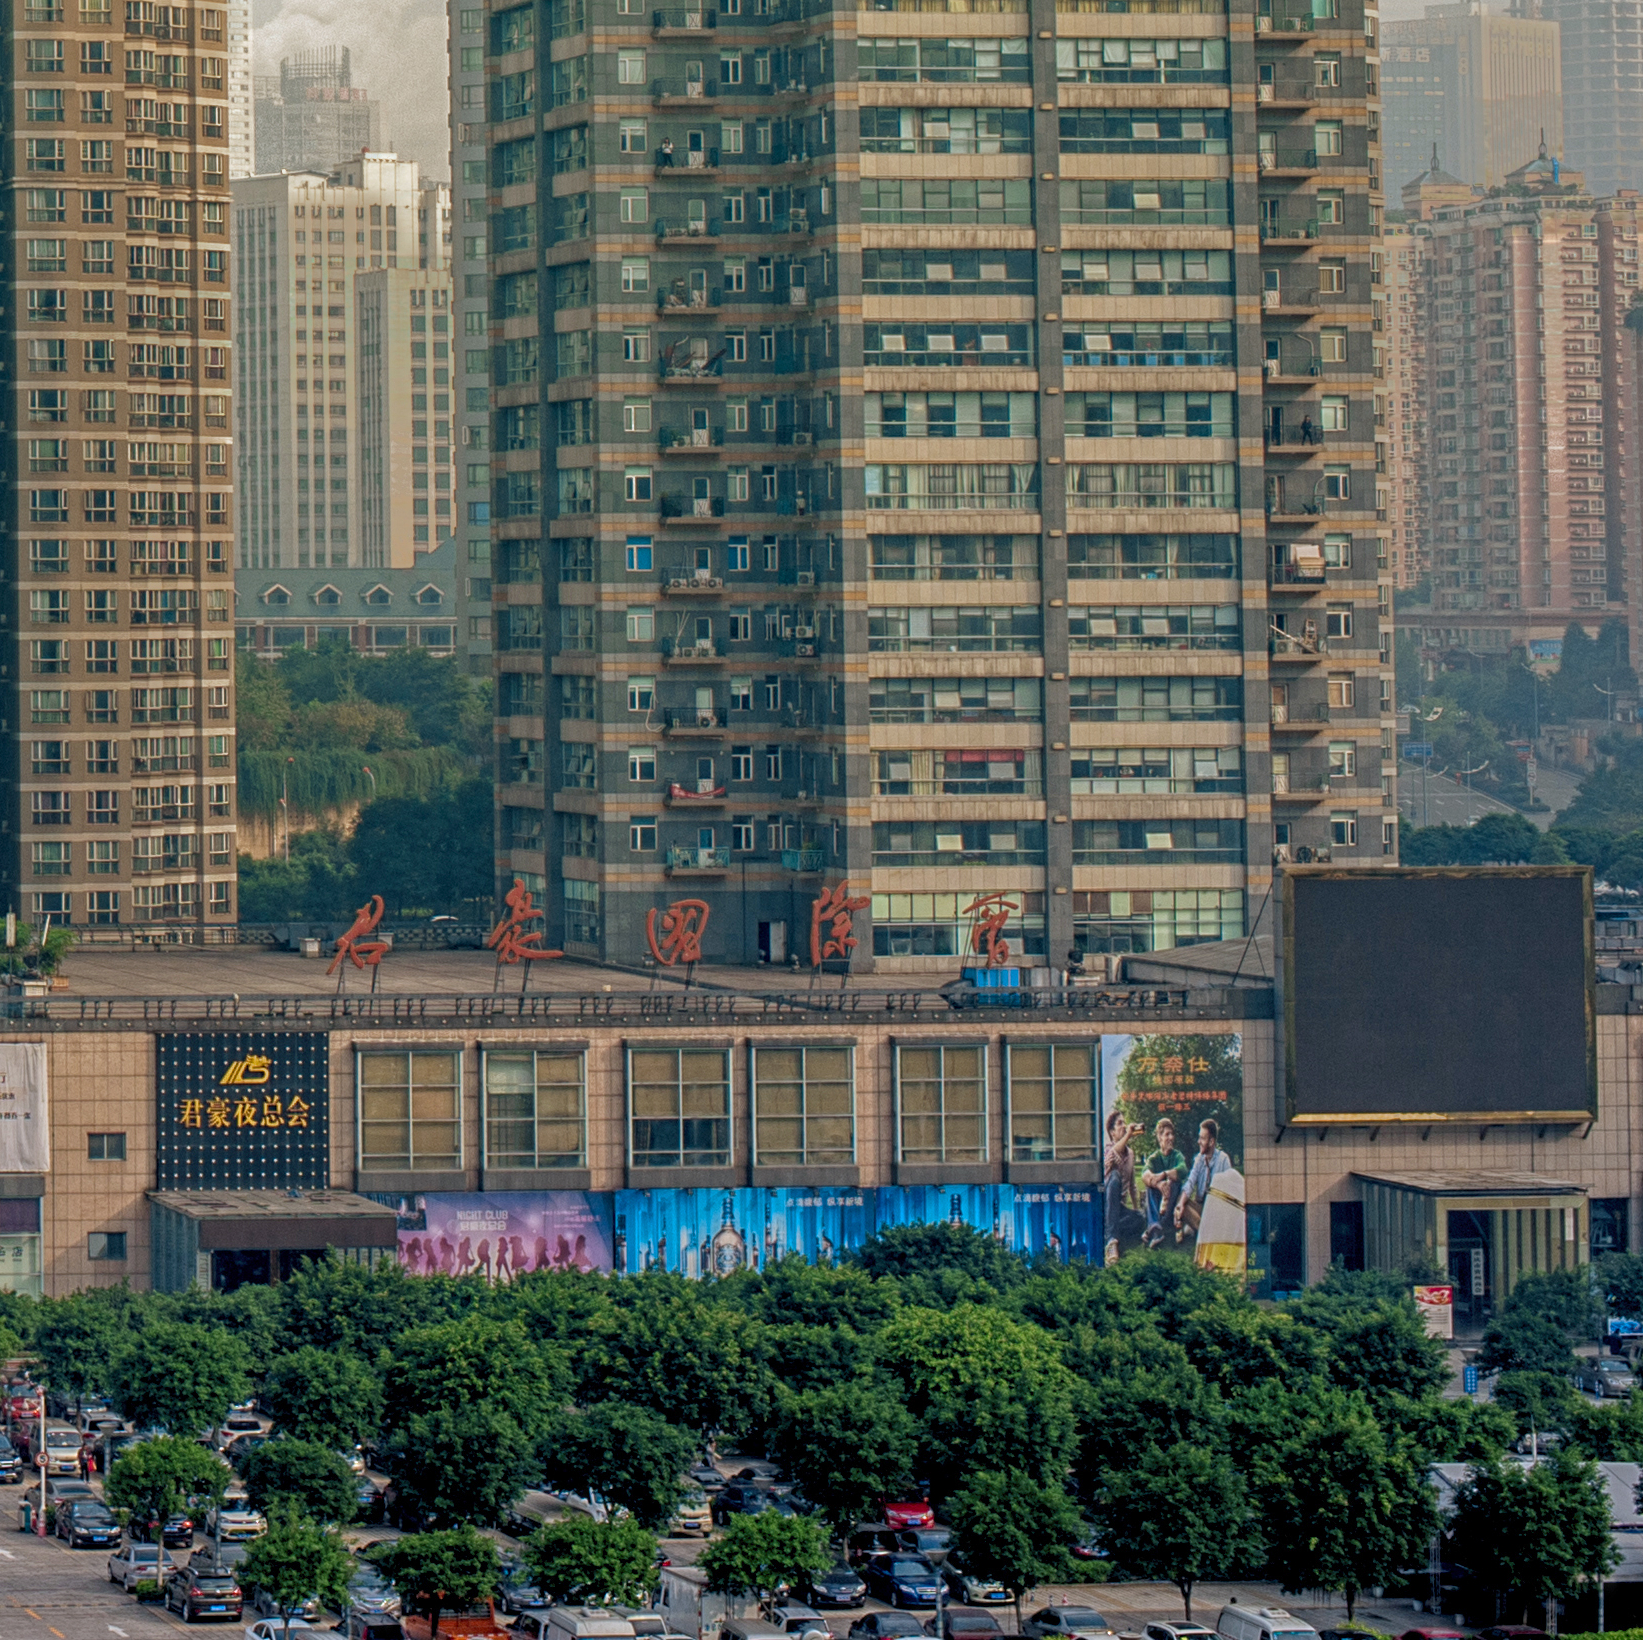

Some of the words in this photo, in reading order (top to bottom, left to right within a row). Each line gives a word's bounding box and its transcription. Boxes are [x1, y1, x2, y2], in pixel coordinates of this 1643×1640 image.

[180, 1095, 311, 1128] 君豪夜总会
[485, 1210, 508, 1220] CLUB
